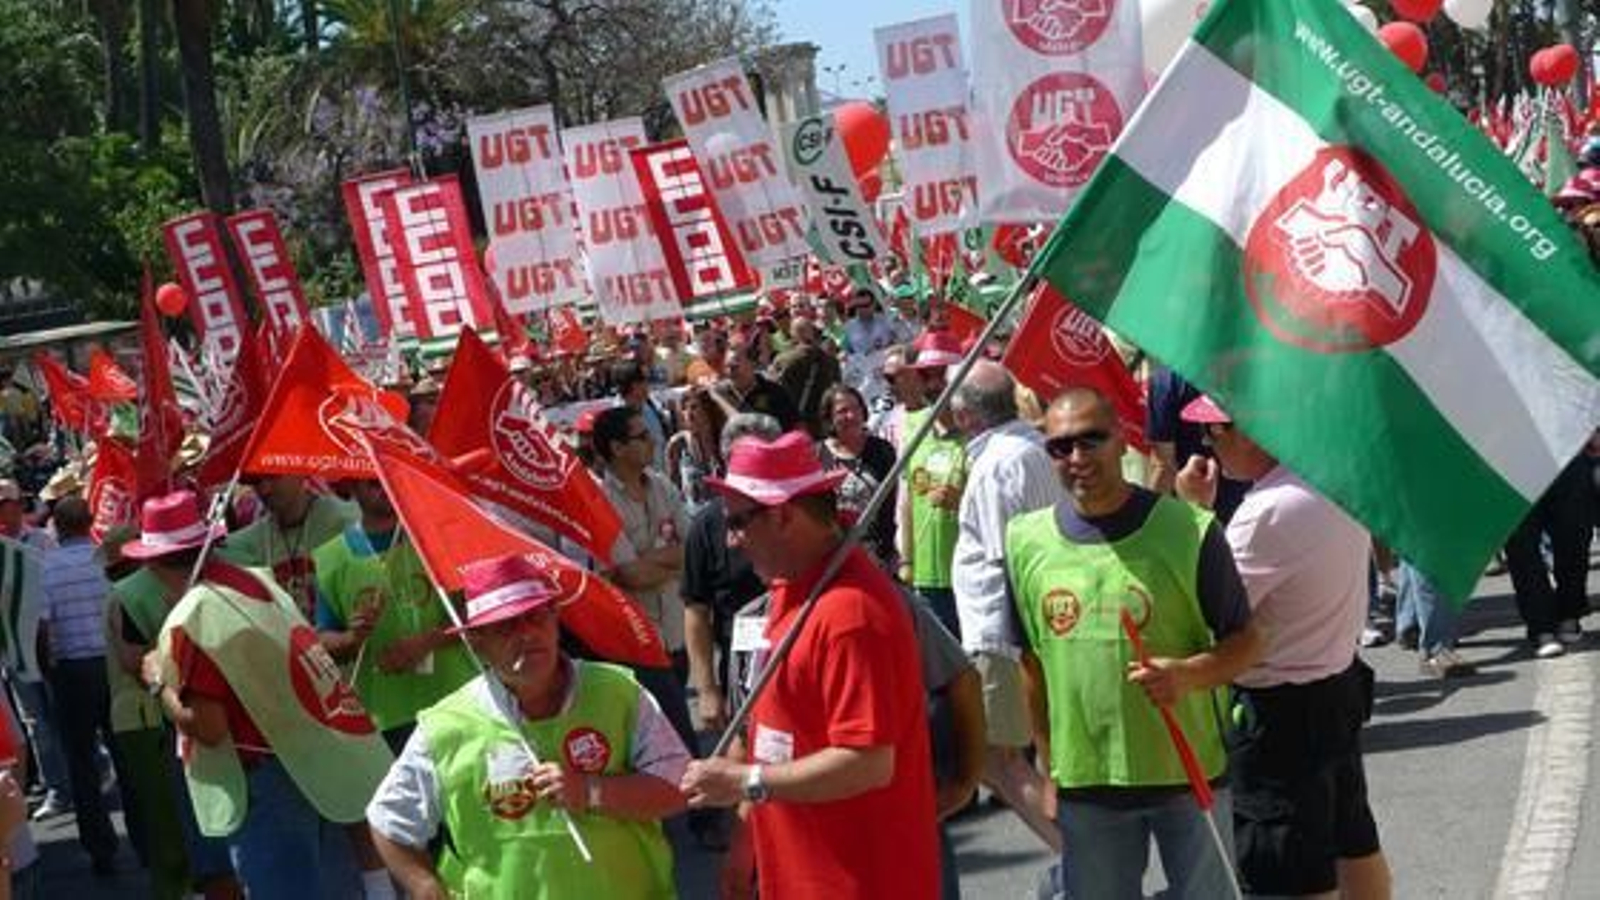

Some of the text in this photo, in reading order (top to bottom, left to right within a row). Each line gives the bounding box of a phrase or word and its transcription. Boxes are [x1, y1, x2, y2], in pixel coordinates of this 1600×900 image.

[887, 34, 957, 78] UGT
[679, 76, 748, 125] UGT
[480, 124, 551, 169] UGT
[902, 106, 969, 149] UGT
[1295, 22, 1557, 261] www.ugt-andalucia.org
[707, 143, 777, 189] UGT
[494, 192, 564, 237] UGT
[647, 146, 736, 295] CCOO
[811, 174, 876, 260] CSI-F
[915, 176, 977, 221] UGT
[737, 206, 806, 251] UGT
[394, 182, 476, 337] CCOO
[506, 258, 576, 300] UGT
[603, 269, 671, 308] UGT
